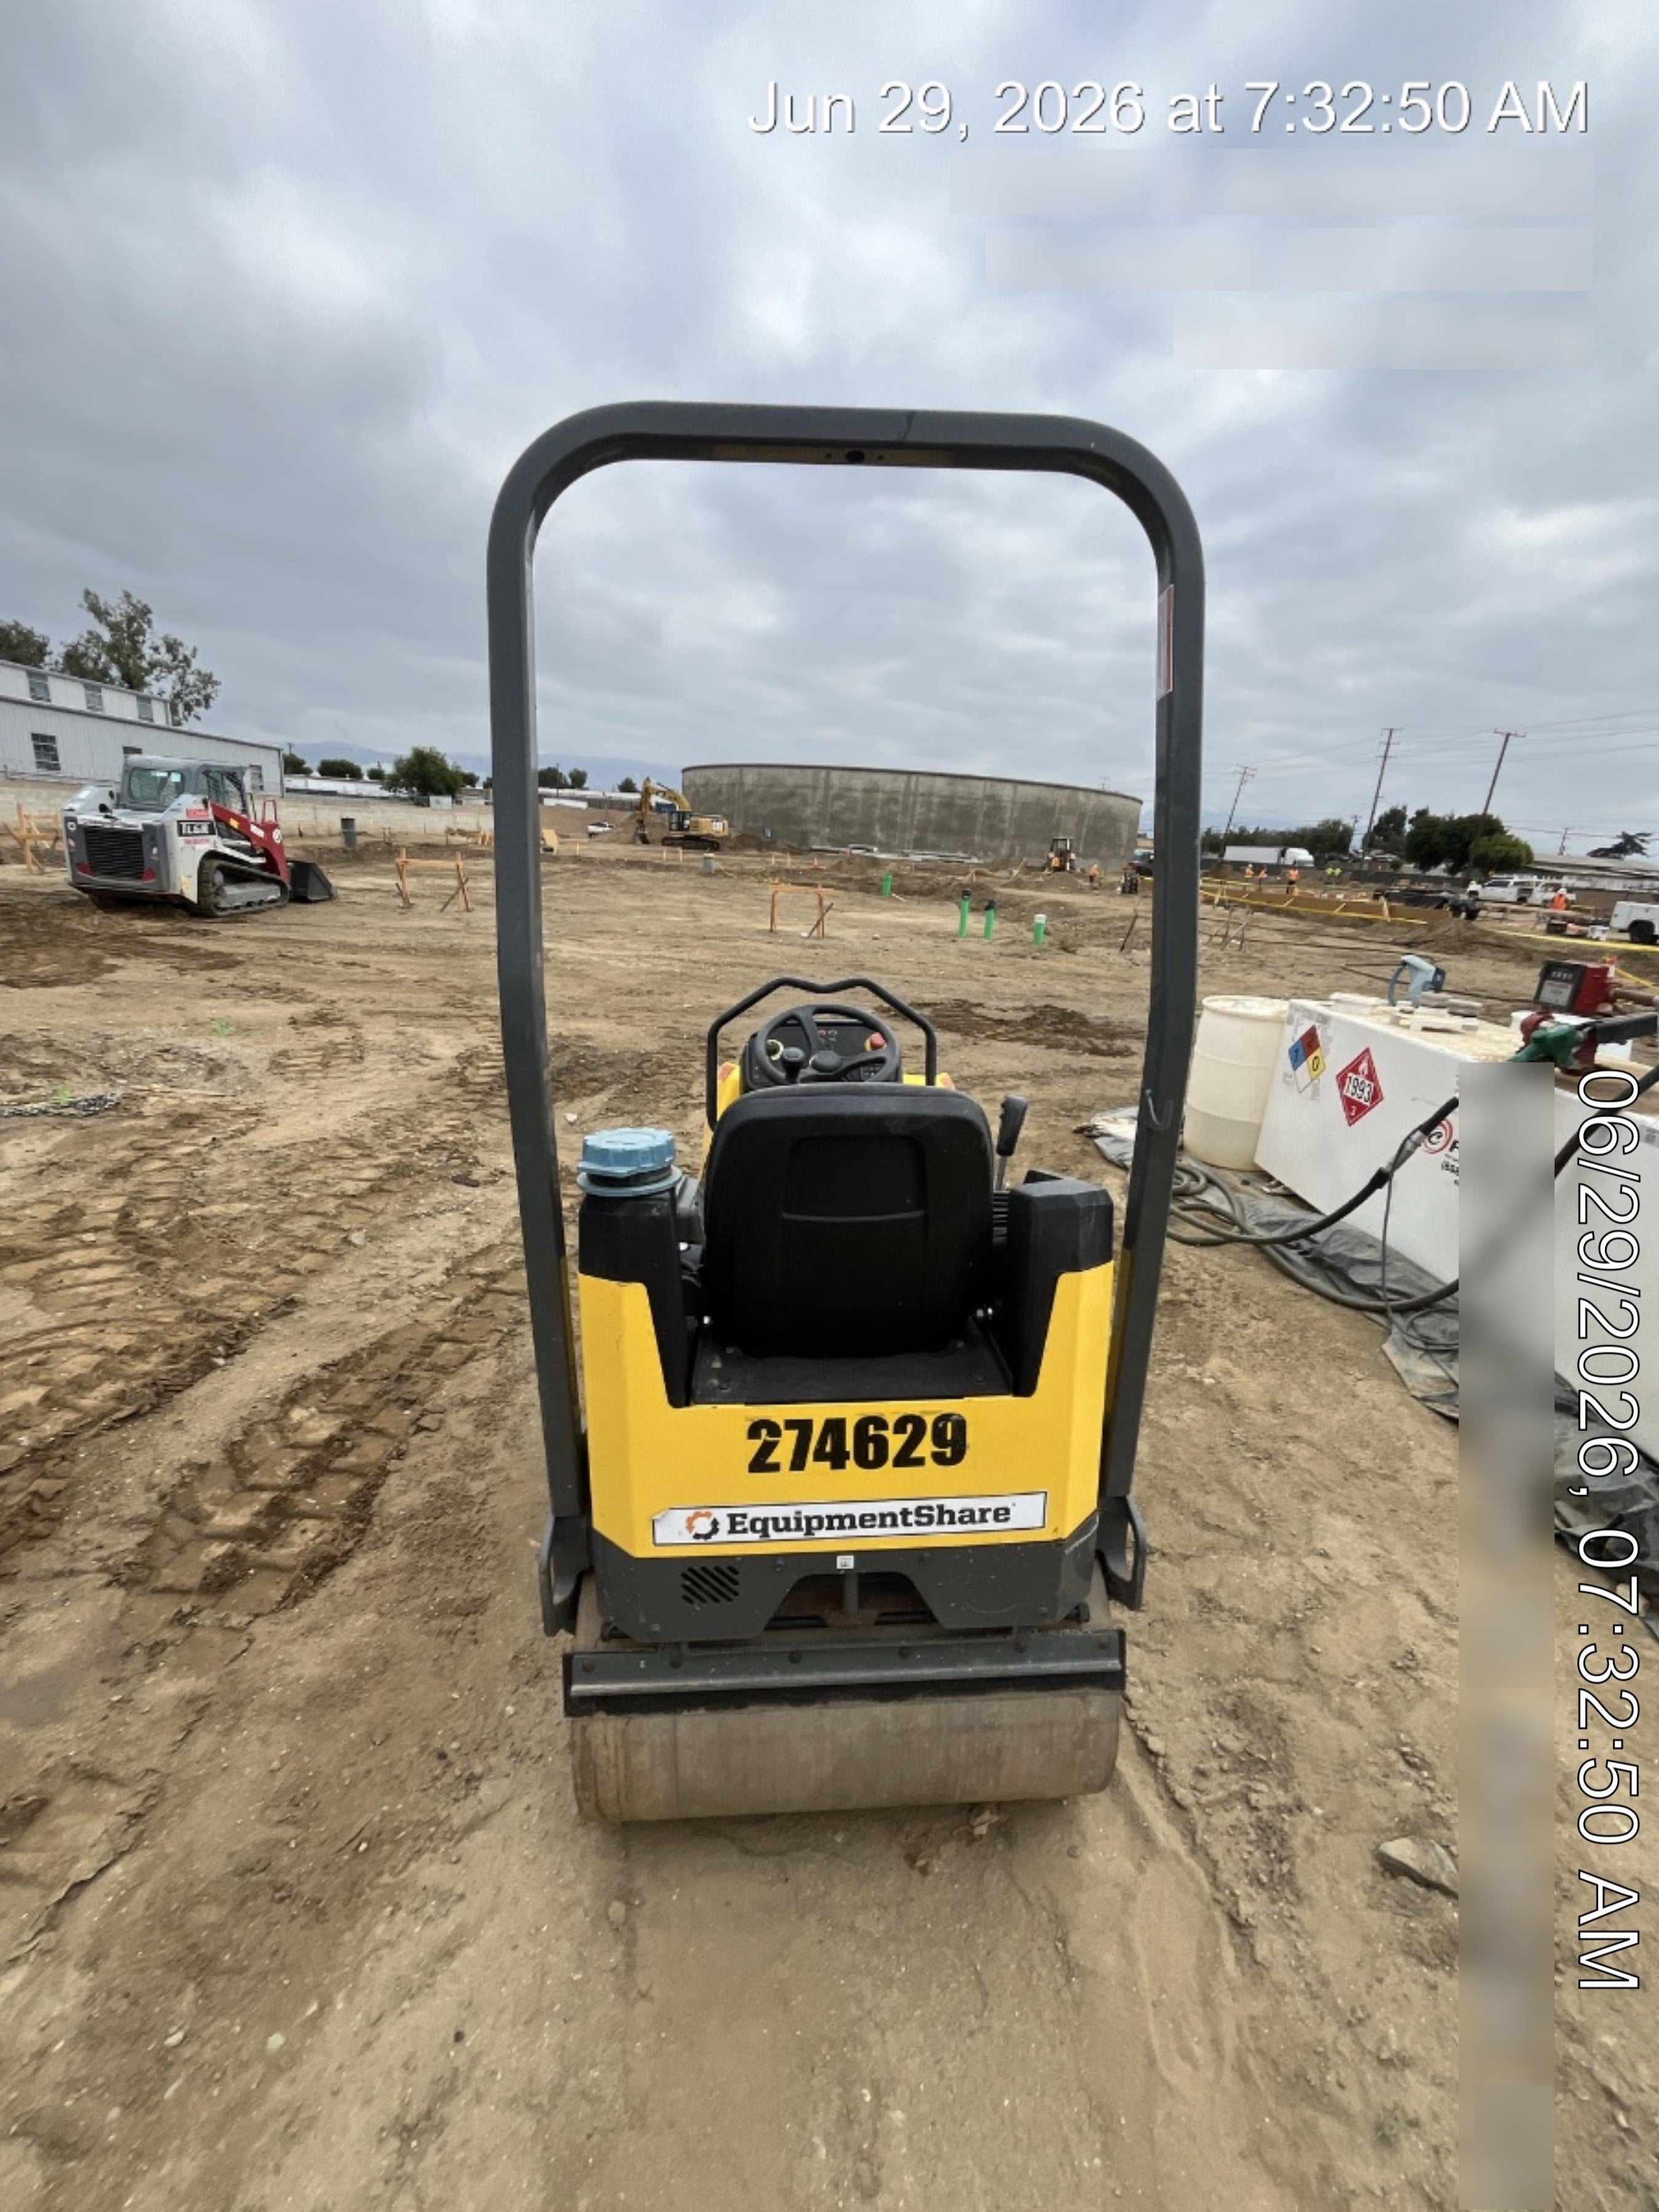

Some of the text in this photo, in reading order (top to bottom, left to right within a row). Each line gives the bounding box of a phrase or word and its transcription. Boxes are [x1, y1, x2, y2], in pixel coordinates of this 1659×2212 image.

[1312, 1056, 1320, 1072] 0
[1346, 1076, 1372, 1103] 1993
[747, 1412, 968, 1473] 274629
[727, 1504, 1011, 1537] EquipmentShare
